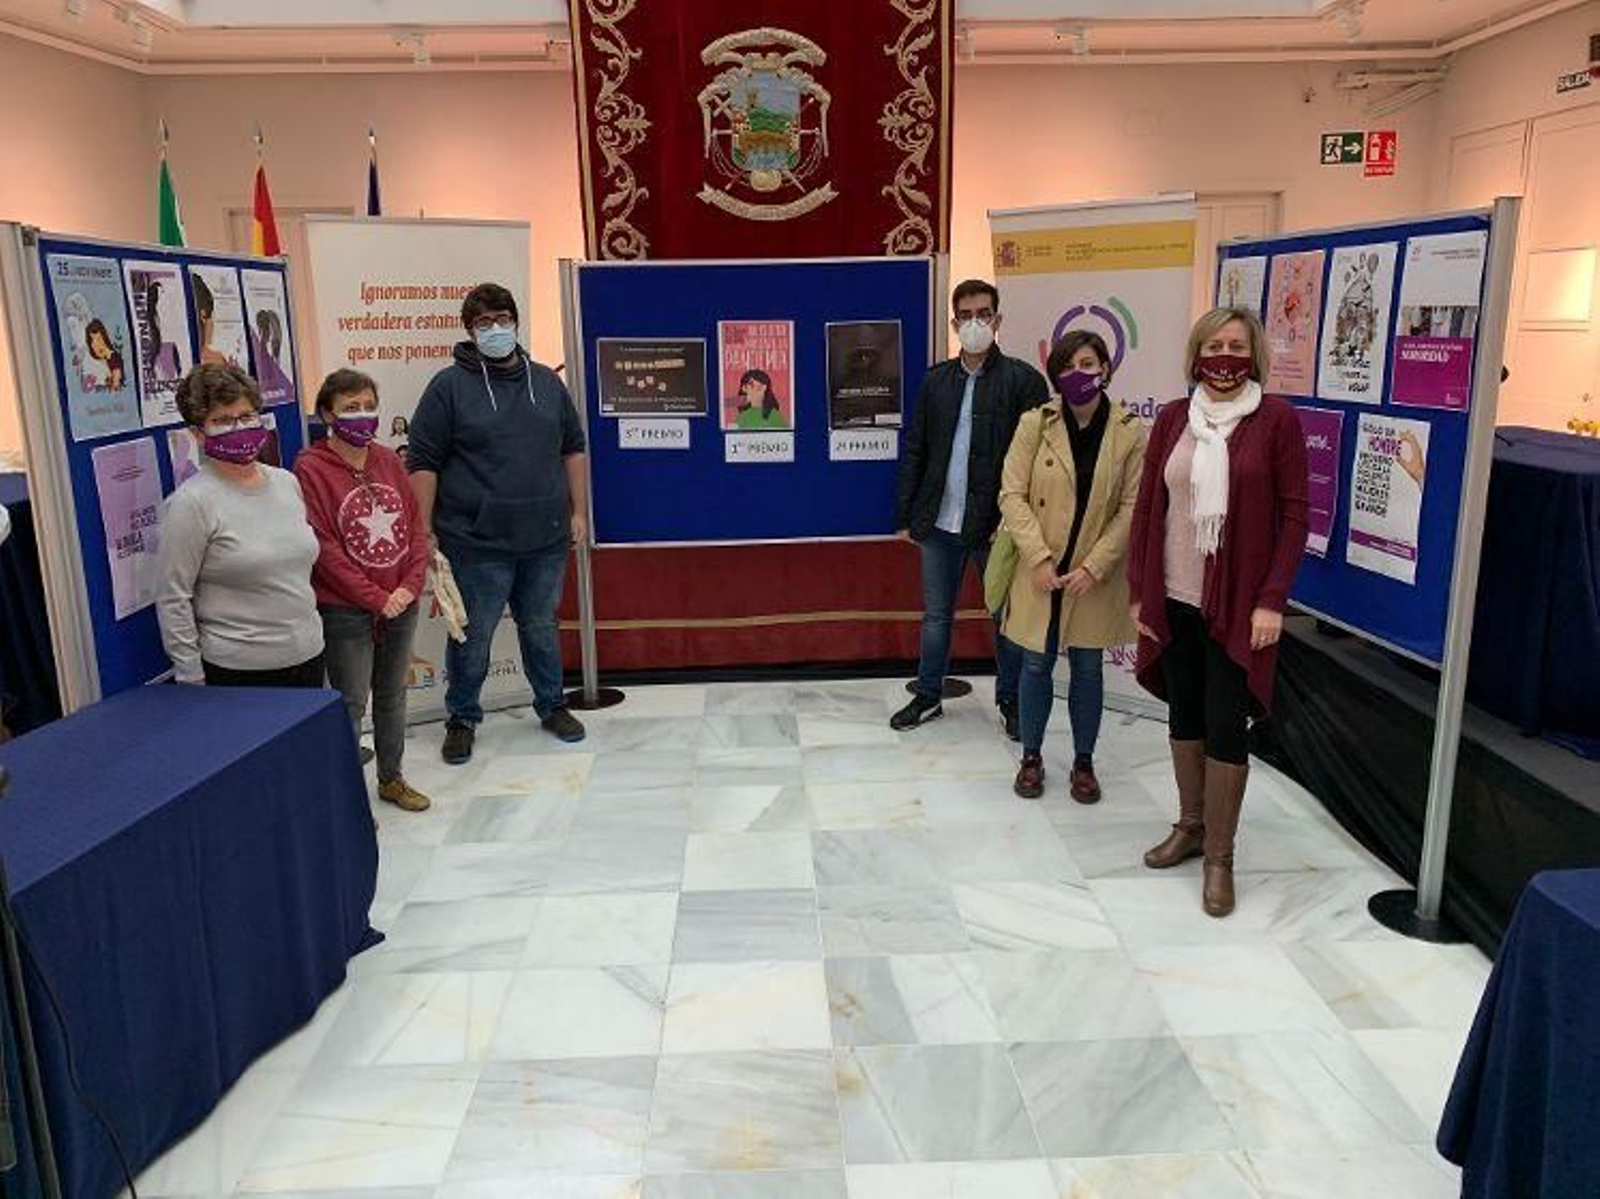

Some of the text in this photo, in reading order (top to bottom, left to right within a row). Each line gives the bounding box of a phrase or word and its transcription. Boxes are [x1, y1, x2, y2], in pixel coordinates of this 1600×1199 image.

[360, 281, 437, 305] Ignoramos
[338, 311, 412, 332] verdadera
[348, 346, 375, 366] que
[378, 345, 403, 360] nos
